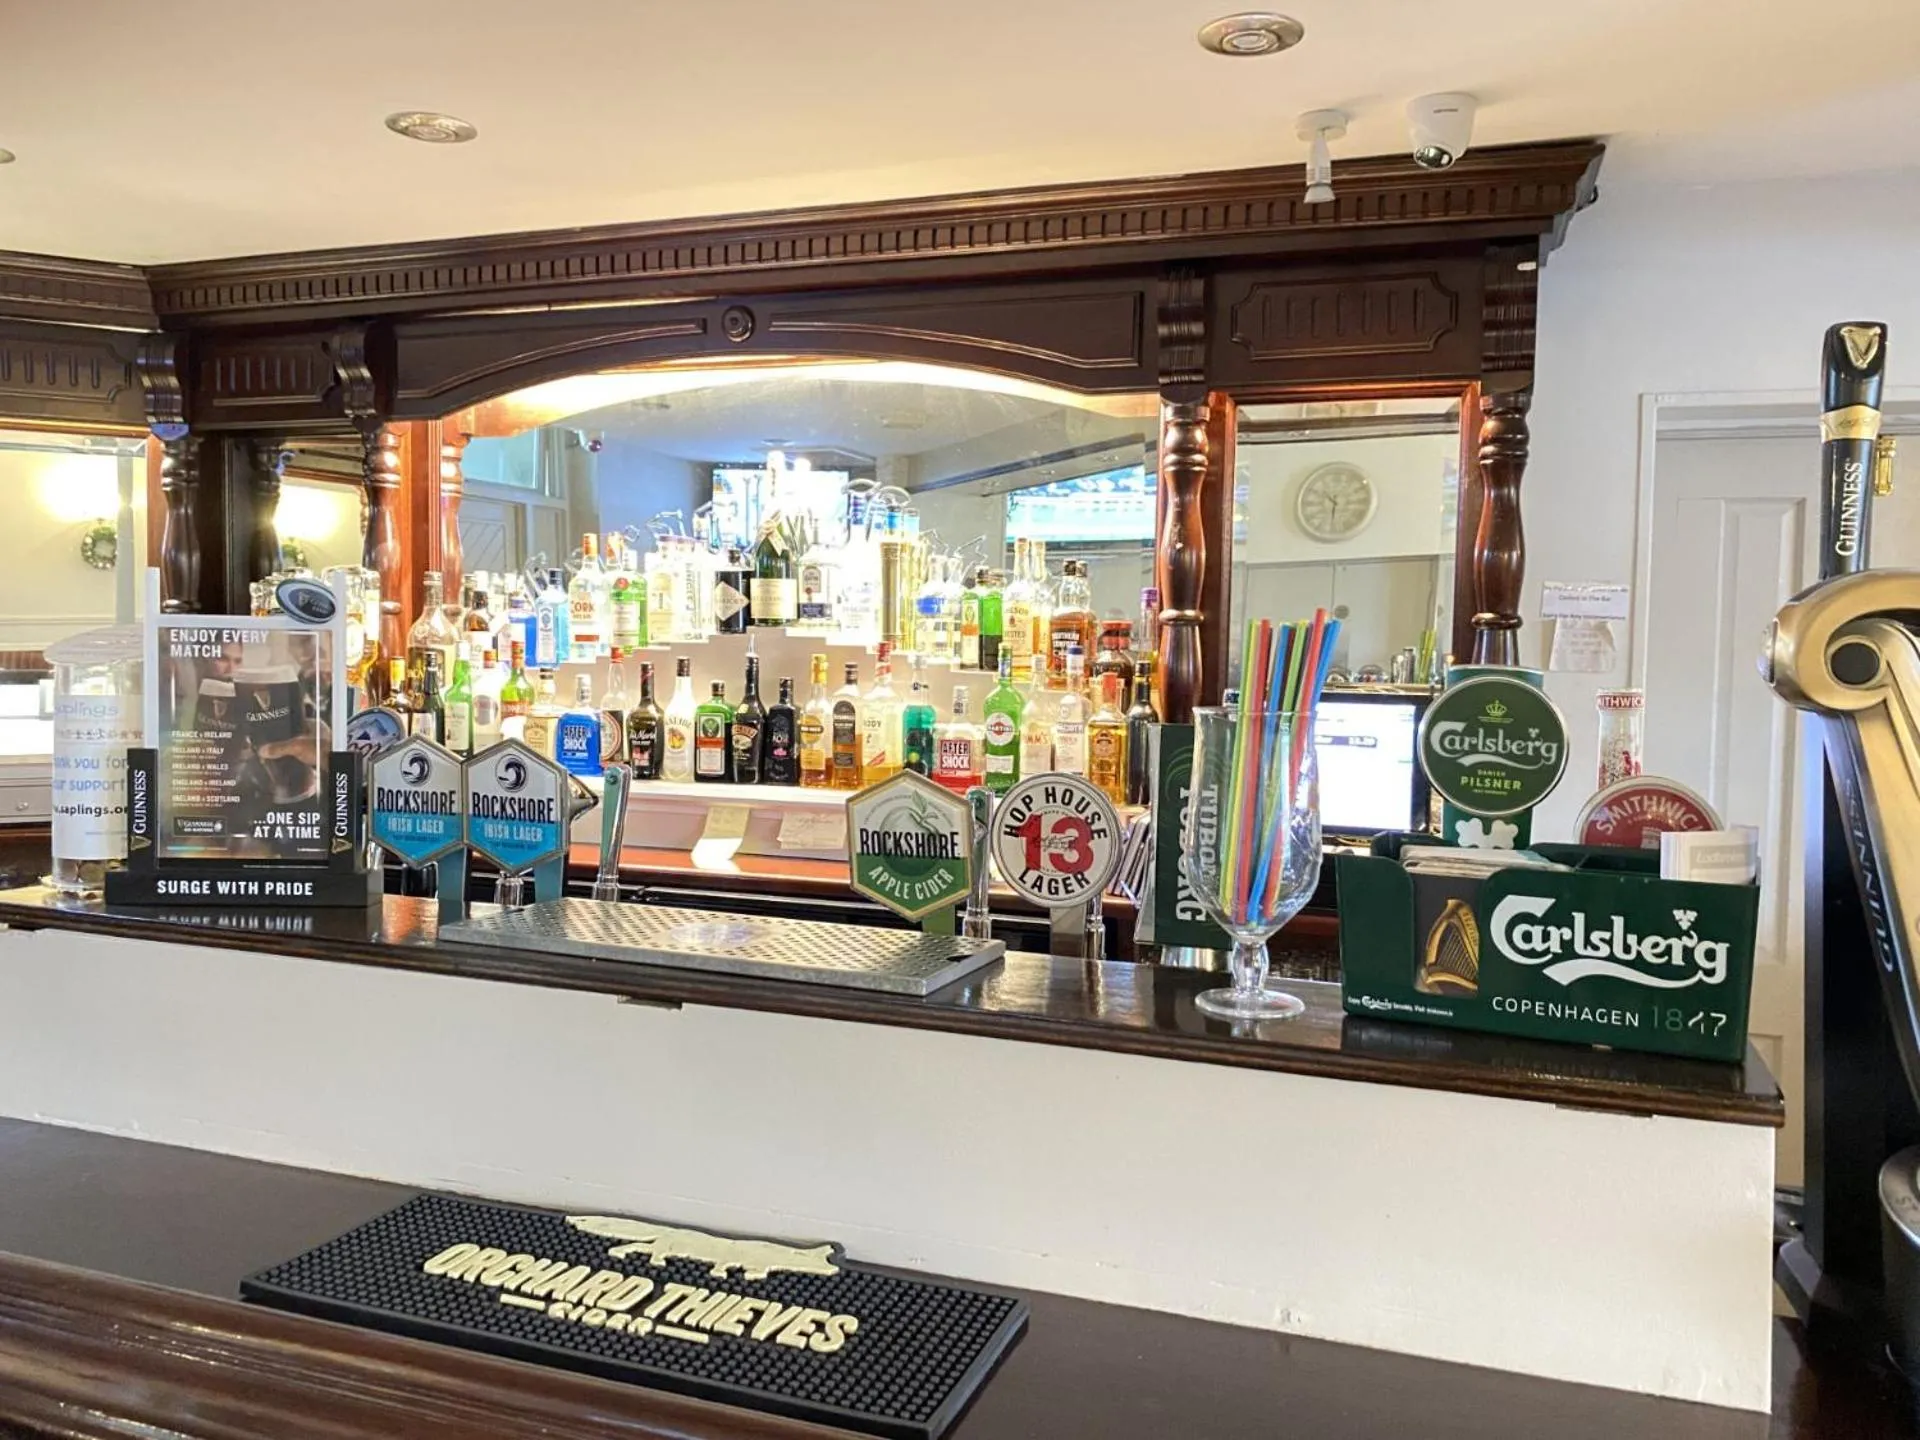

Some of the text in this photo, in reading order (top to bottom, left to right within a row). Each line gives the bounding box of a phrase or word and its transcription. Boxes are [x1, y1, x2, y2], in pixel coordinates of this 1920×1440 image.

[1835, 461, 1861, 557] GUINNESS
[170, 629, 269, 643] ENJOY EVERY
[170, 644, 222, 658] MATCH
[246, 707, 290, 722] GUINNESS
[941, 741, 969, 755] AFTER
[1430, 721, 1559, 769] Carlsberg
[941, 754, 970, 769] SHOCK
[1460, 776, 1522, 791] PILSNER
[133, 769, 147, 834] GUINNESS
[334, 772, 348, 837] GUINNESS
[377, 787, 457, 816] ROCKSHORE
[472, 792, 555, 824] ROCKSHORE
[1003, 786, 1108, 841] HOP HOUSE
[1596, 795, 1705, 836] SMITHWIC
[253, 811, 321, 825] ...ONE SIP
[253, 826, 321, 839] AT A TIME
[388, 817, 445, 834] IRISH LAGER
[484, 823, 544, 842] IRISH LAGER
[859, 827, 962, 860] ROCKSHORE
[1015, 813, 1095, 874] 13
[157, 880, 314, 896] SURGE WITH PRIDE
[868, 865, 955, 900] APPLE CIDER
[1018, 867, 1091, 896] LAGER
[1489, 894, 1731, 988] Carlsberg
[1492, 996, 1728, 1038] COPENHAGEN 1847
[422, 1242, 859, 1353] ORCHARD THIEVES
[547, 1300, 656, 1335] CIDER
